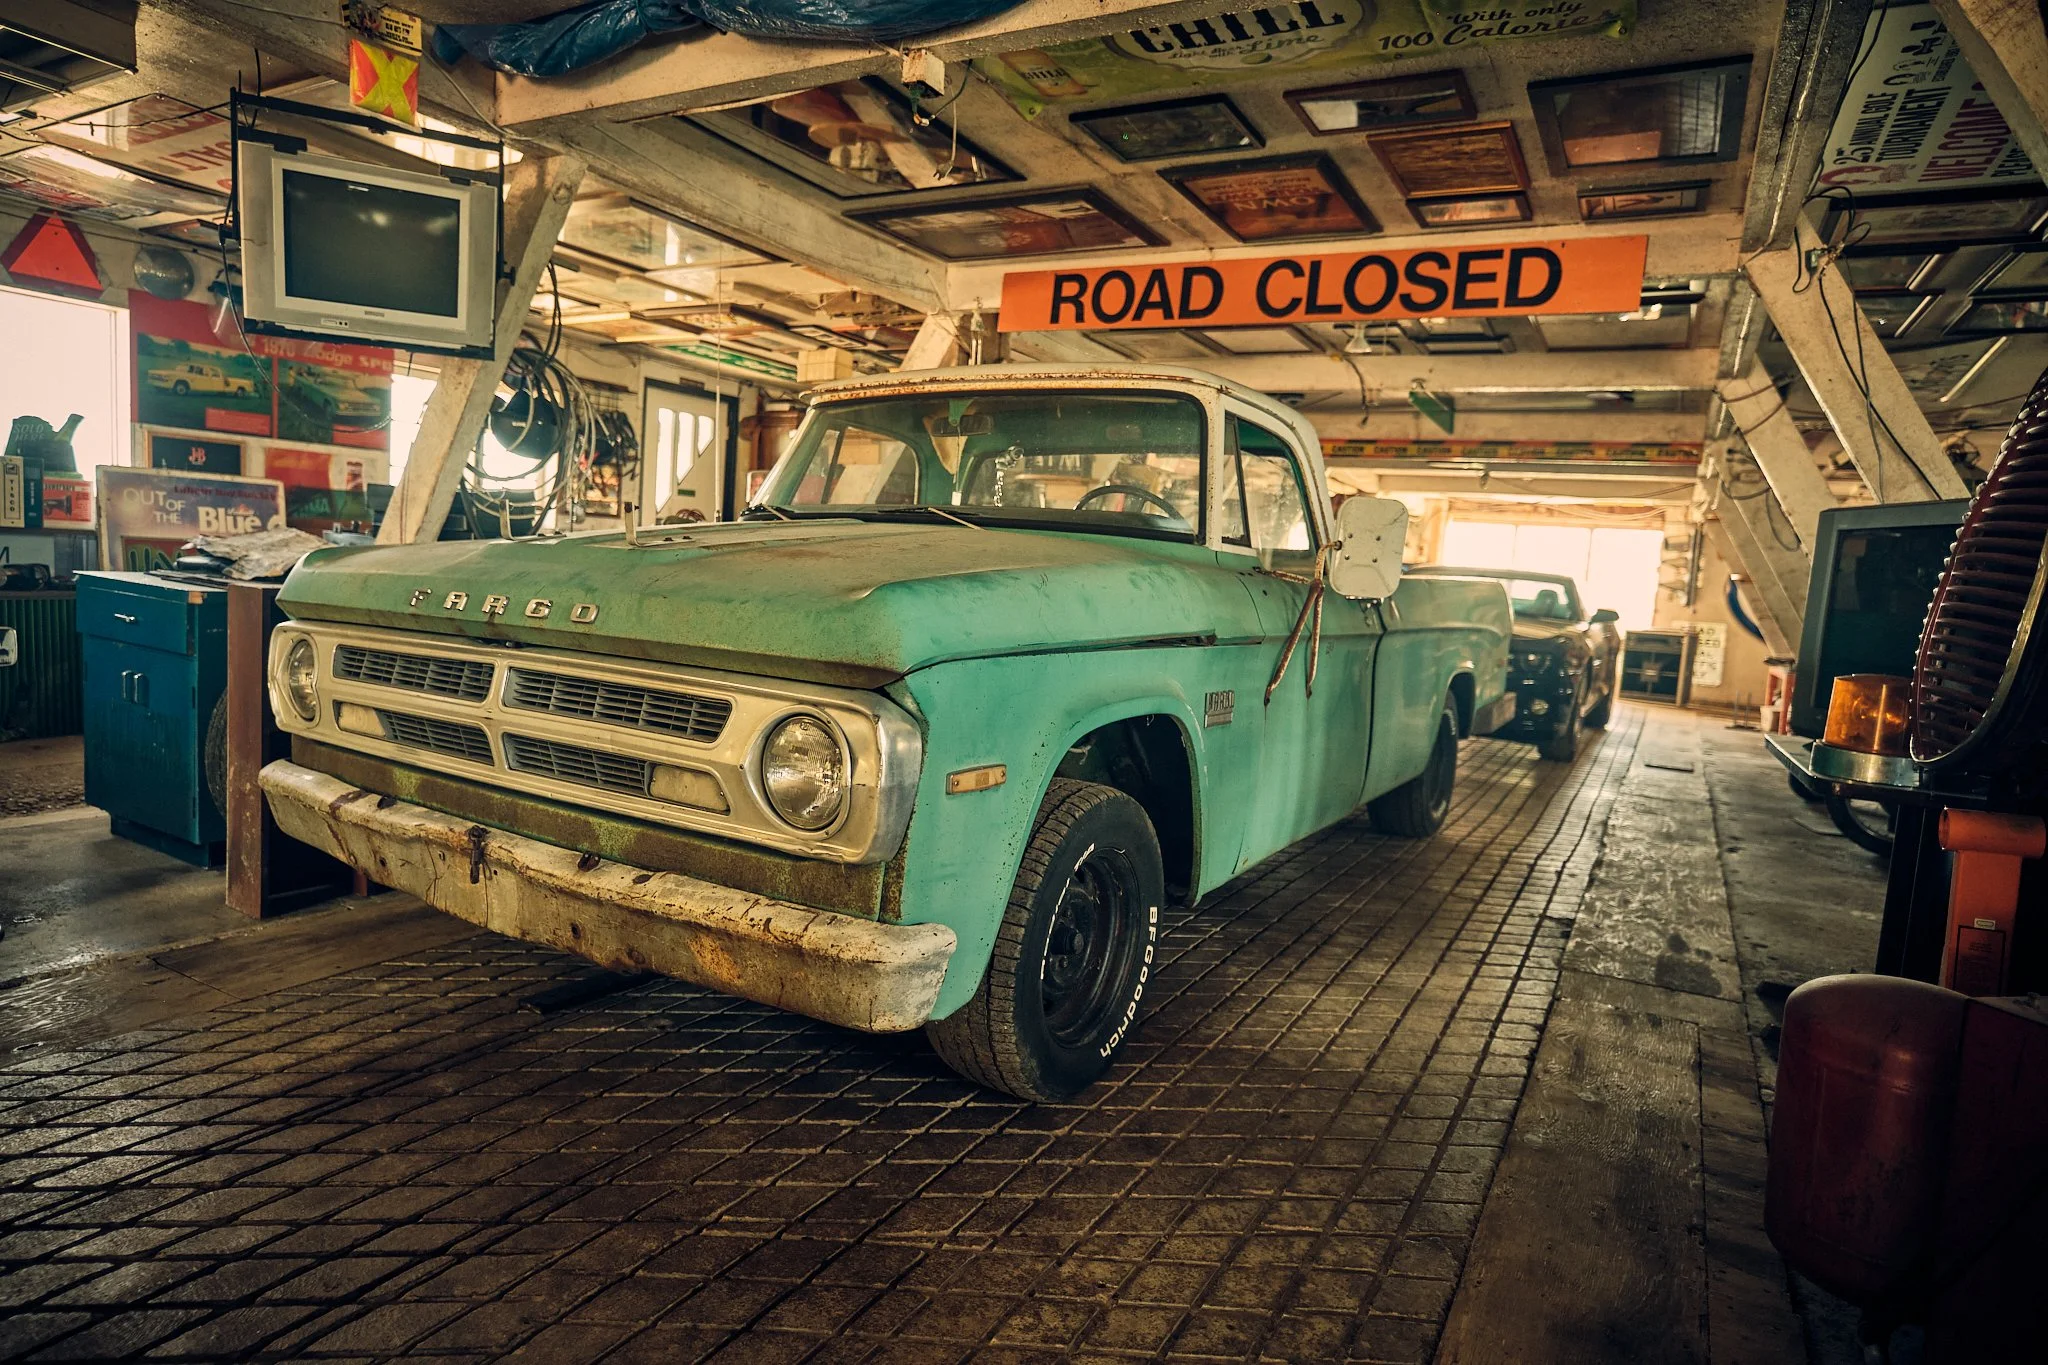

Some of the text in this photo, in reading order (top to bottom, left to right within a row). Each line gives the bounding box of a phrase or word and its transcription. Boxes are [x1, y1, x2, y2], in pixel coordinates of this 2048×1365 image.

[1129, 1, 1346, 53] CHILL
[1447, 1, 1586, 25] With only
[1378, 31, 1434, 50] 100
[1861, 92, 1899, 117] GOLF
[1849, 113, 1889, 147] ANNUAL
[1875, 86, 1952, 163] TOURNAMENT
[1049, 246, 1563, 325] ROAD CLOSED
[123, 487, 167, 505] OUT
[165, 498, 186, 512] OF
[153, 511, 183, 525] THE
[197, 506, 261, 534] Blue
[409, 587, 600, 624] FARGO
[1099, 906, 1158, 1058] BFGoodrich
